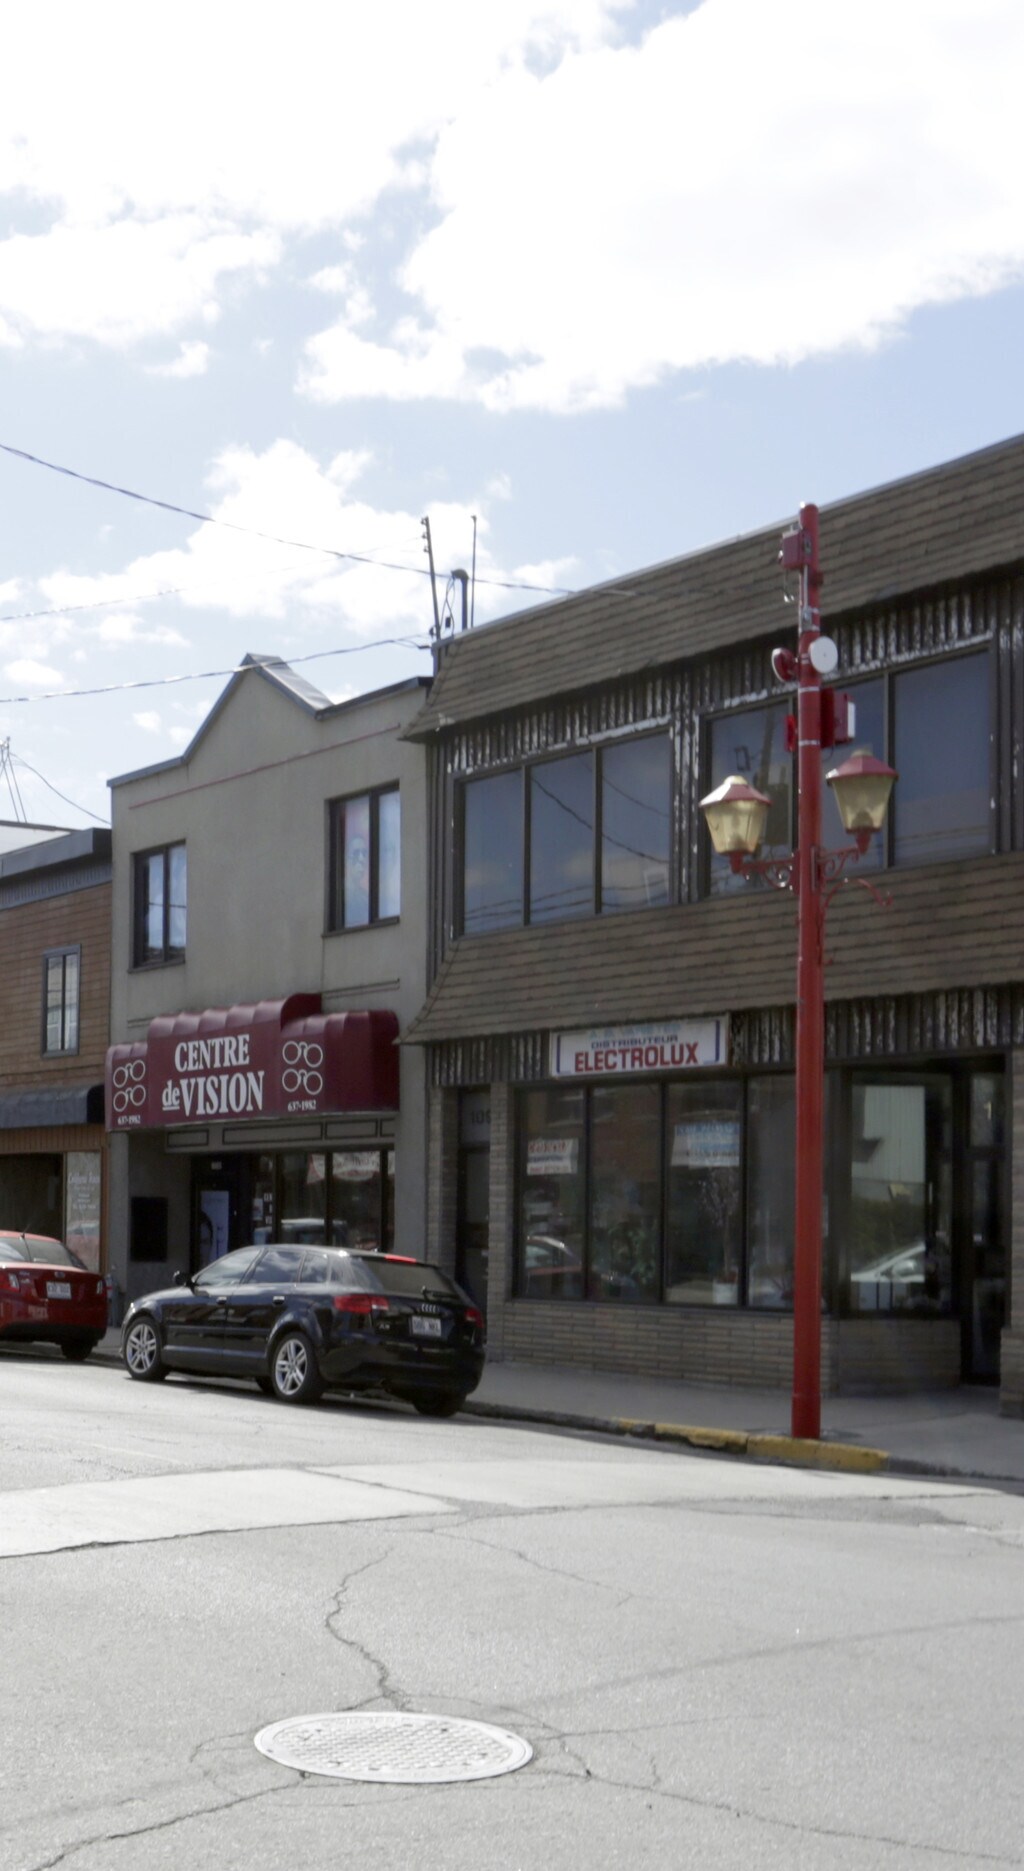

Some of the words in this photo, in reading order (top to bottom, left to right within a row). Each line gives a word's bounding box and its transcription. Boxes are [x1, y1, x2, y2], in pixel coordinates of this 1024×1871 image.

[174, 1033, 250, 1072] CENTRE
[574, 1042, 699, 1073] ELECTROLUX
[590, 1034, 679, 1050] DISTRIBUTEUR
[179, 1070, 265, 1117] VISION
